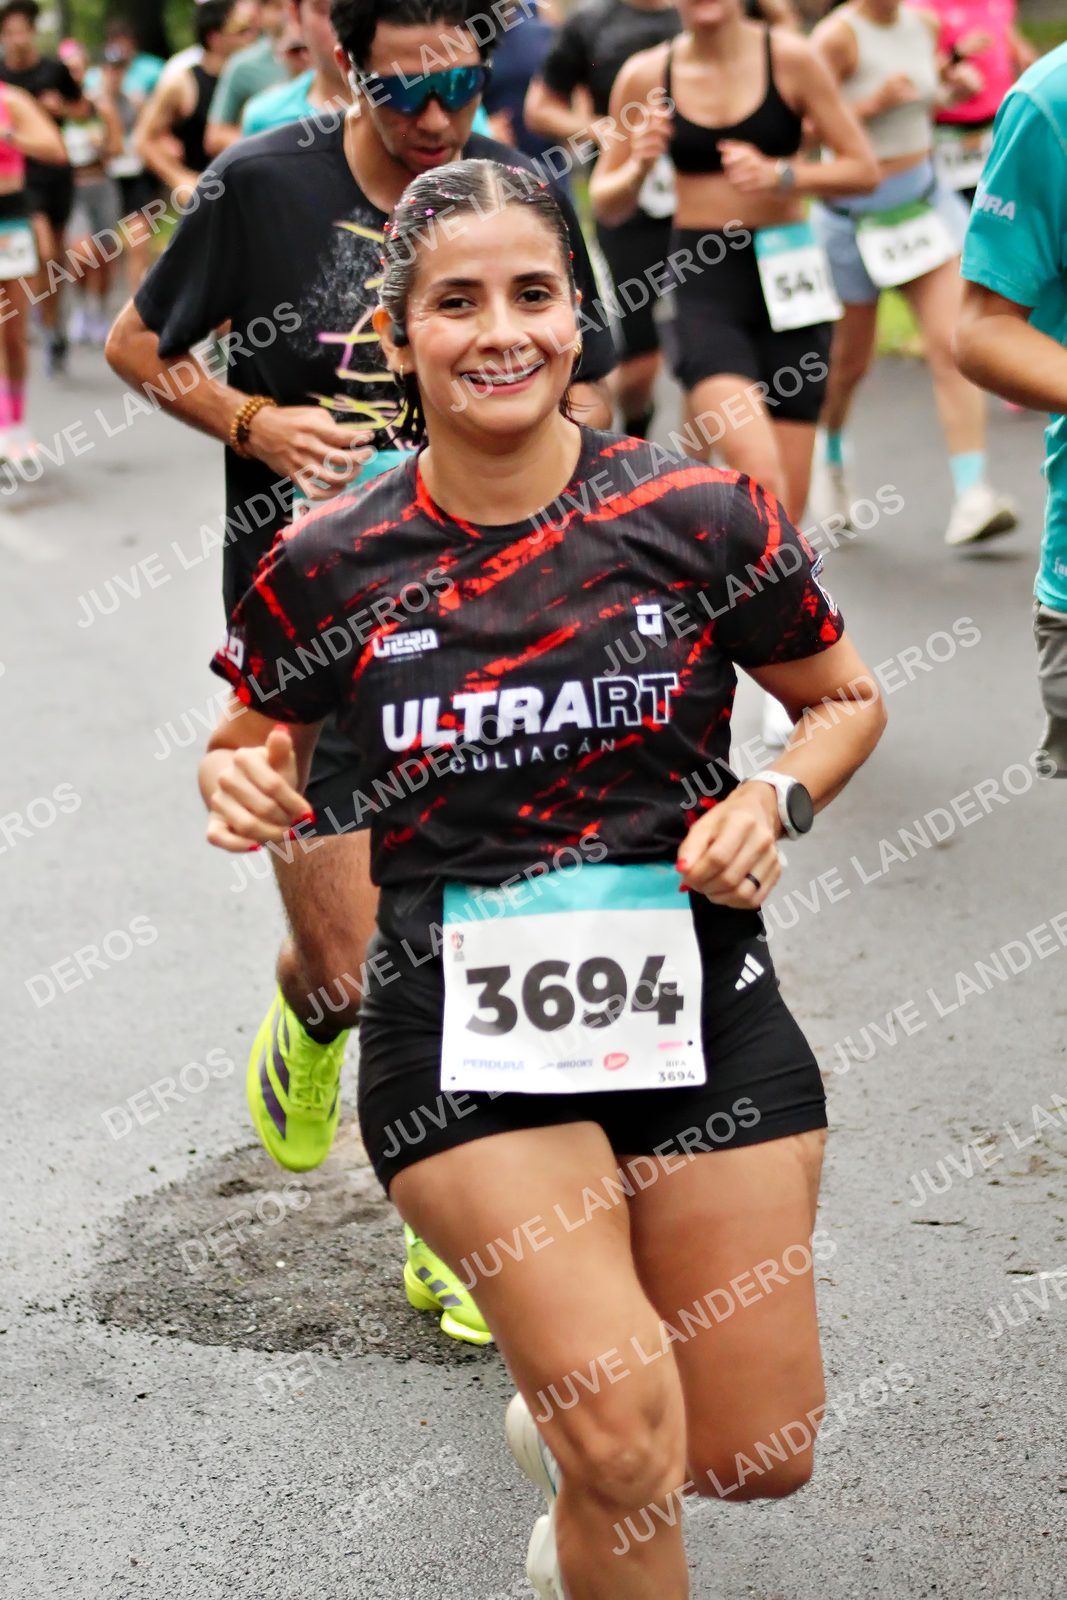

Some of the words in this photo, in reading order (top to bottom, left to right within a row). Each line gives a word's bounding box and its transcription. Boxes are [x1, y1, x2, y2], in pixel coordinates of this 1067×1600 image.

[382, 673, 679, 753] ULTRART
[450, 737, 616, 774] CULIACÁN
[464, 955, 685, 1037] 3694
[657, 1070, 696, 1083] 3694
